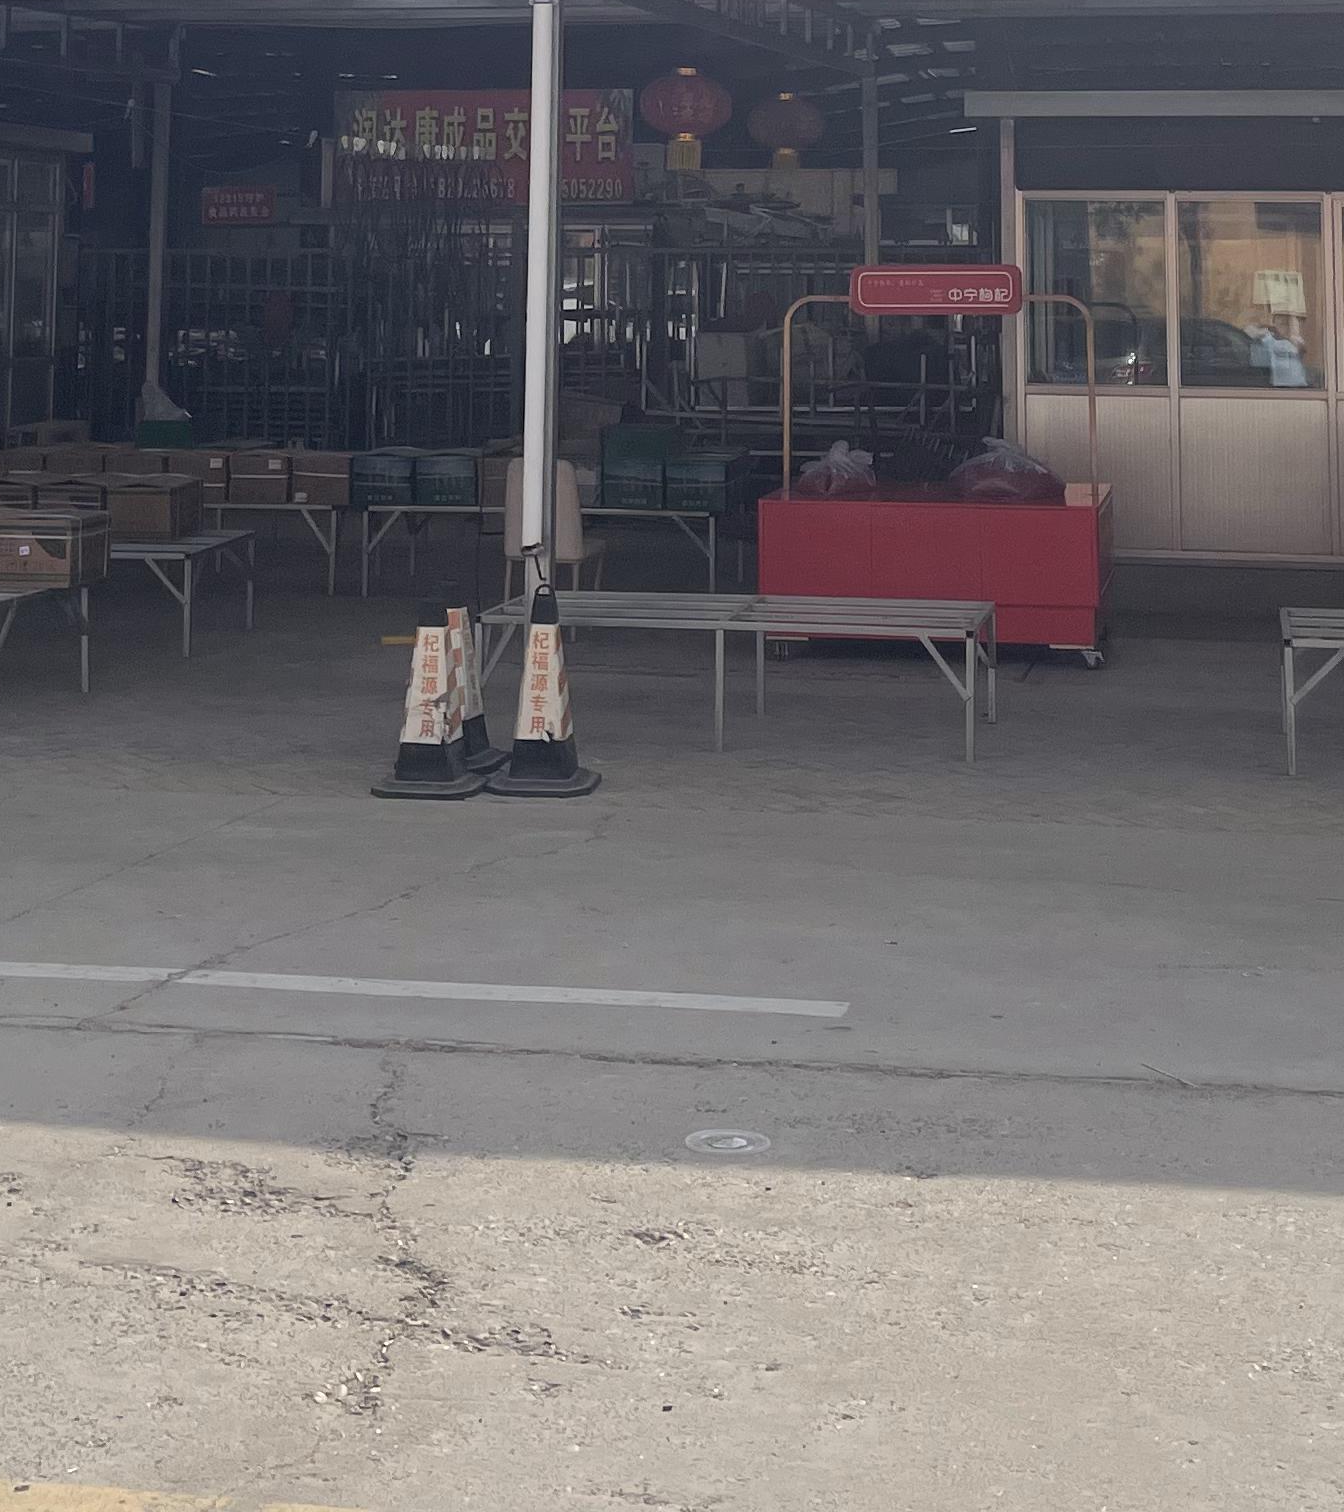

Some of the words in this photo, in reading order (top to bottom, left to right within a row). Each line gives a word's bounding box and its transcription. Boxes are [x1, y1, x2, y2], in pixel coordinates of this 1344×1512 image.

[353, 106, 620, 162] 润达康成品交平台
[418, 633, 440, 738] 杞福源专用
[529, 630, 549, 735] 杞福源专用
